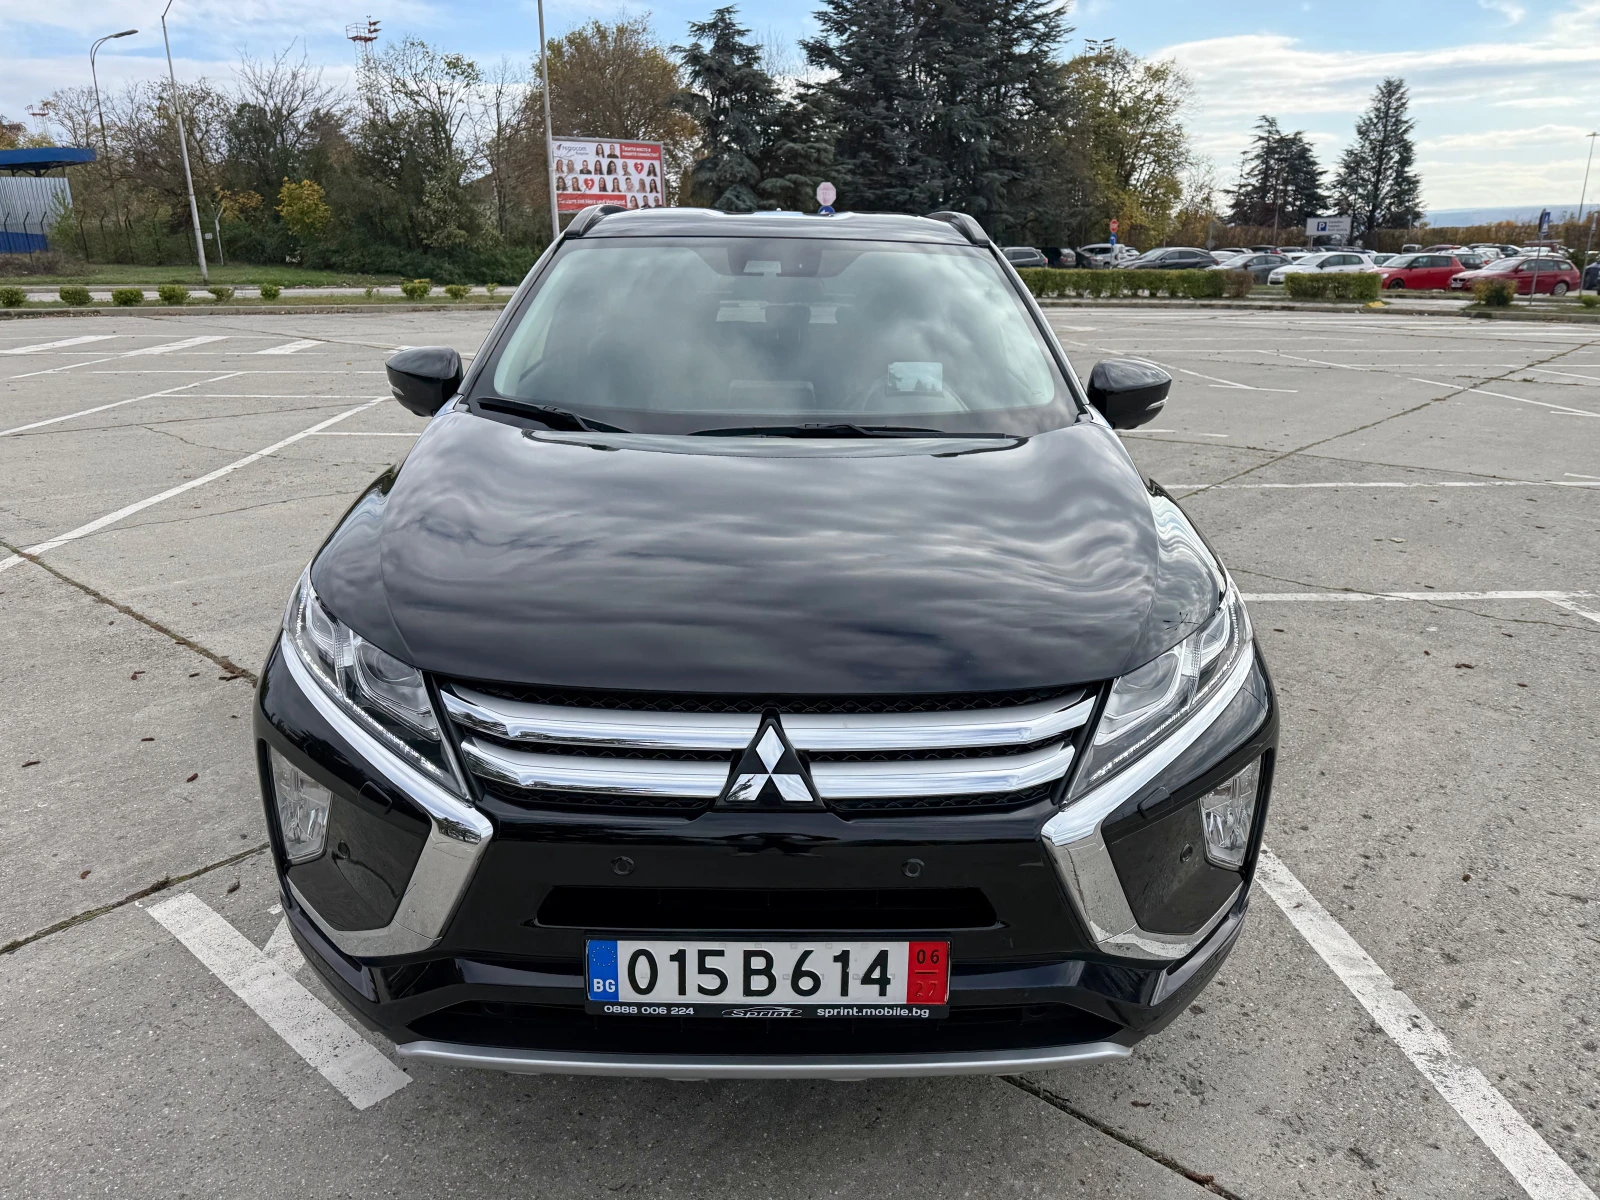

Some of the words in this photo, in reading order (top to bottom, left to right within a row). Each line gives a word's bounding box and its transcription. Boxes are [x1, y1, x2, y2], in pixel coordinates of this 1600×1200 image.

[1319, 222, 1325, 231] P
[916, 949, 940, 965] 06
[627, 948, 891, 997] 015B614
[593, 978, 616, 993] BG
[914, 981, 938, 997] 27
[603, 1005, 638, 1014] 0888
[641, 1006, 667, 1015] 006
[670, 1007, 695, 1015] 224
[816, 1006, 930, 1018] sprint.mobile.bg
